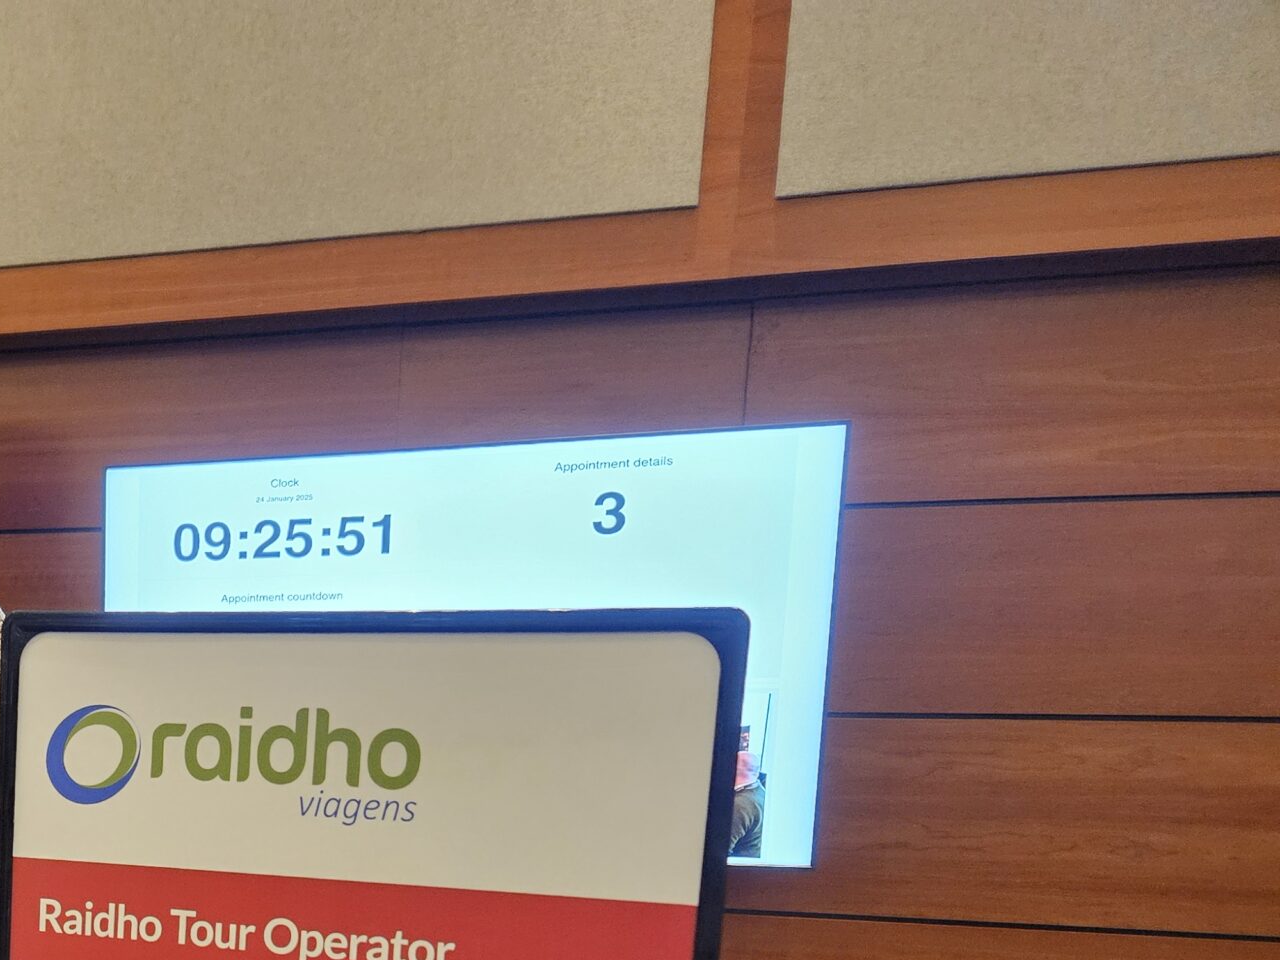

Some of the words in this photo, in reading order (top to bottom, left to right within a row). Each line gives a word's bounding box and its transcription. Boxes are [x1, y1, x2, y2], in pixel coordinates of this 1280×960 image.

[554, 458, 630, 473] Appointment
[633, 456, 673, 468] details
[266, 495, 294, 504] January
[270, 478, 299, 488] Clock
[592, 491, 626, 535] 3
[173, 513, 392, 562] 09:25:51
[221, 593, 284, 605] Appointment
[287, 591, 343, 602] countdown
[150, 706, 421, 790] raidho
[299, 790, 417, 826] viagens
[38, 897, 162, 942] Raidho
[170, 909, 256, 951] Tour
